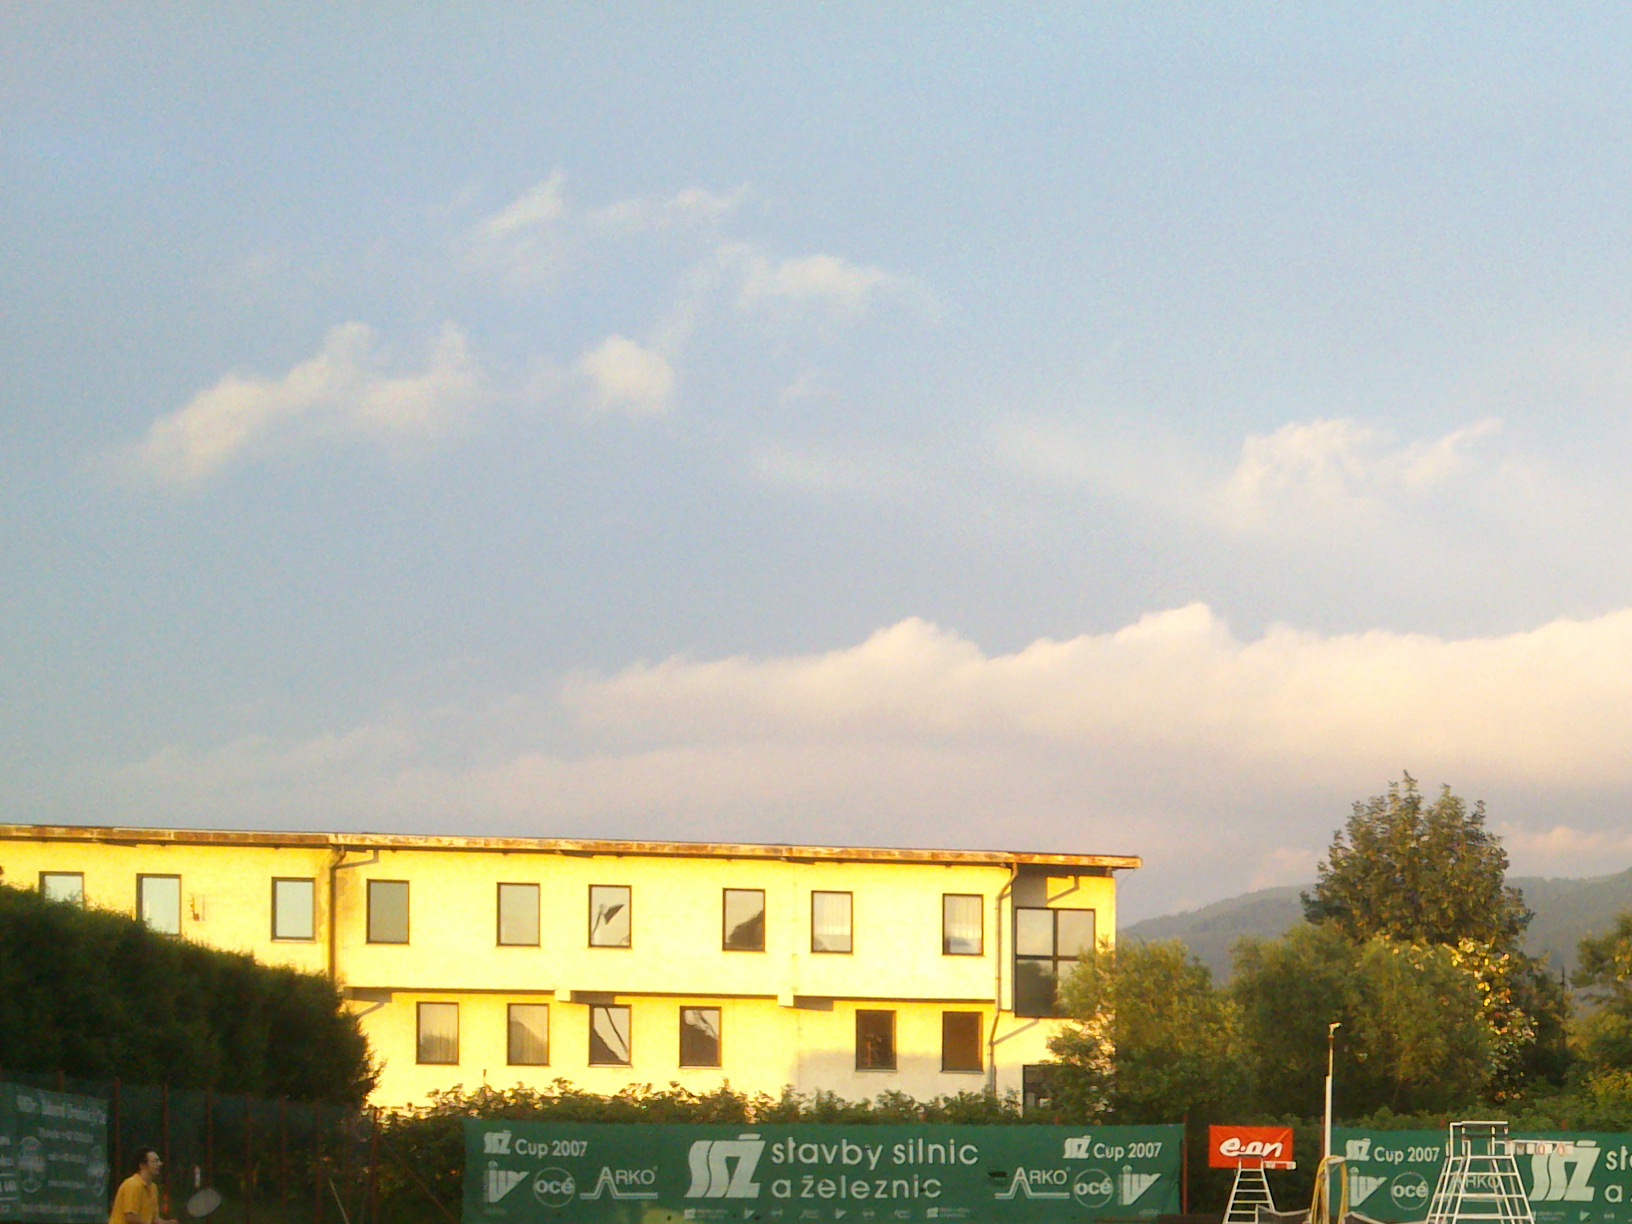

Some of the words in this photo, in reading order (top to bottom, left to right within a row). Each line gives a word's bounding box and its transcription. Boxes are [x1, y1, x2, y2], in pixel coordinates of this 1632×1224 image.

[515, 1139, 549, 1159] Cup
[552, 1140, 588, 1157] 2007
[772, 1137, 883, 1171] stavby
[892, 1138, 979, 1165] silnic
[1093, 1143, 1125, 1162] Cup
[1127, 1142, 1162, 1159] 2007
[1374, 1146, 1405, 1165] Cup
[1407, 1146, 1440, 1162] 2007
[772, 1179, 791, 1198] a
[801, 1175, 942, 1199] železnic
[1604, 1184, 1623, 1203] a
